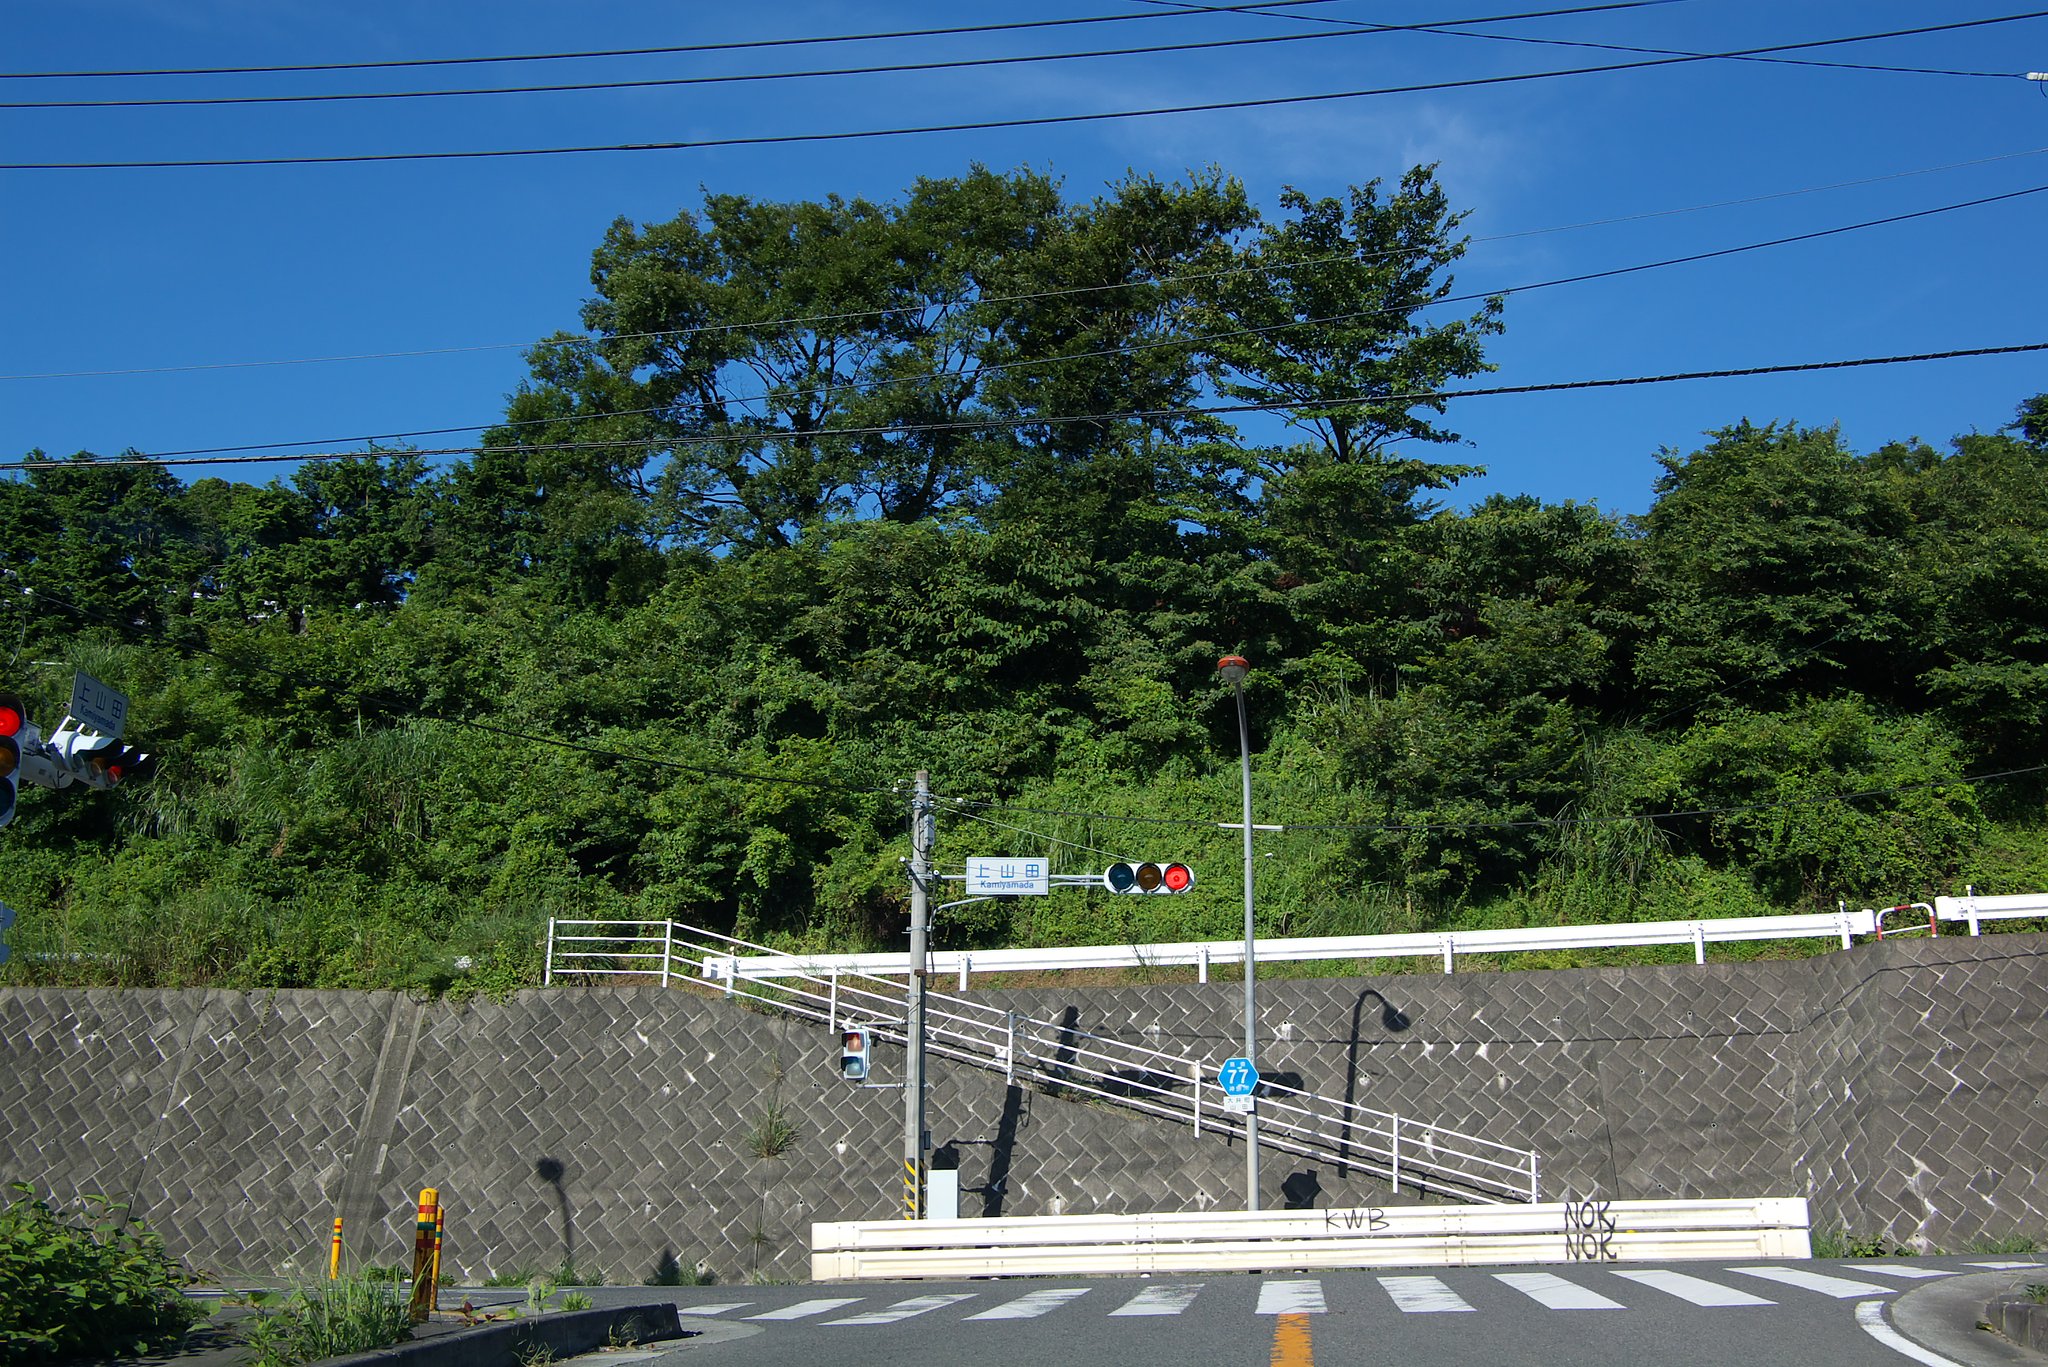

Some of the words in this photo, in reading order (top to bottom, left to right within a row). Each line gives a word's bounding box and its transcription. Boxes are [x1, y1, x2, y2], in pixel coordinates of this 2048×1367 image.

[79, 682, 123, 719] 上山田
[80, 703, 116, 730] Kamiyamada
[975, 863, 1039, 878] 上山田
[980, 880, 1034, 890] Kamiyamada
[1227, 1069, 1249, 1084] 77
[1325, 1208, 1390, 1232] KWB
[1565, 1201, 1616, 1232] NOK
[1566, 1232, 1617, 1262] NOK
